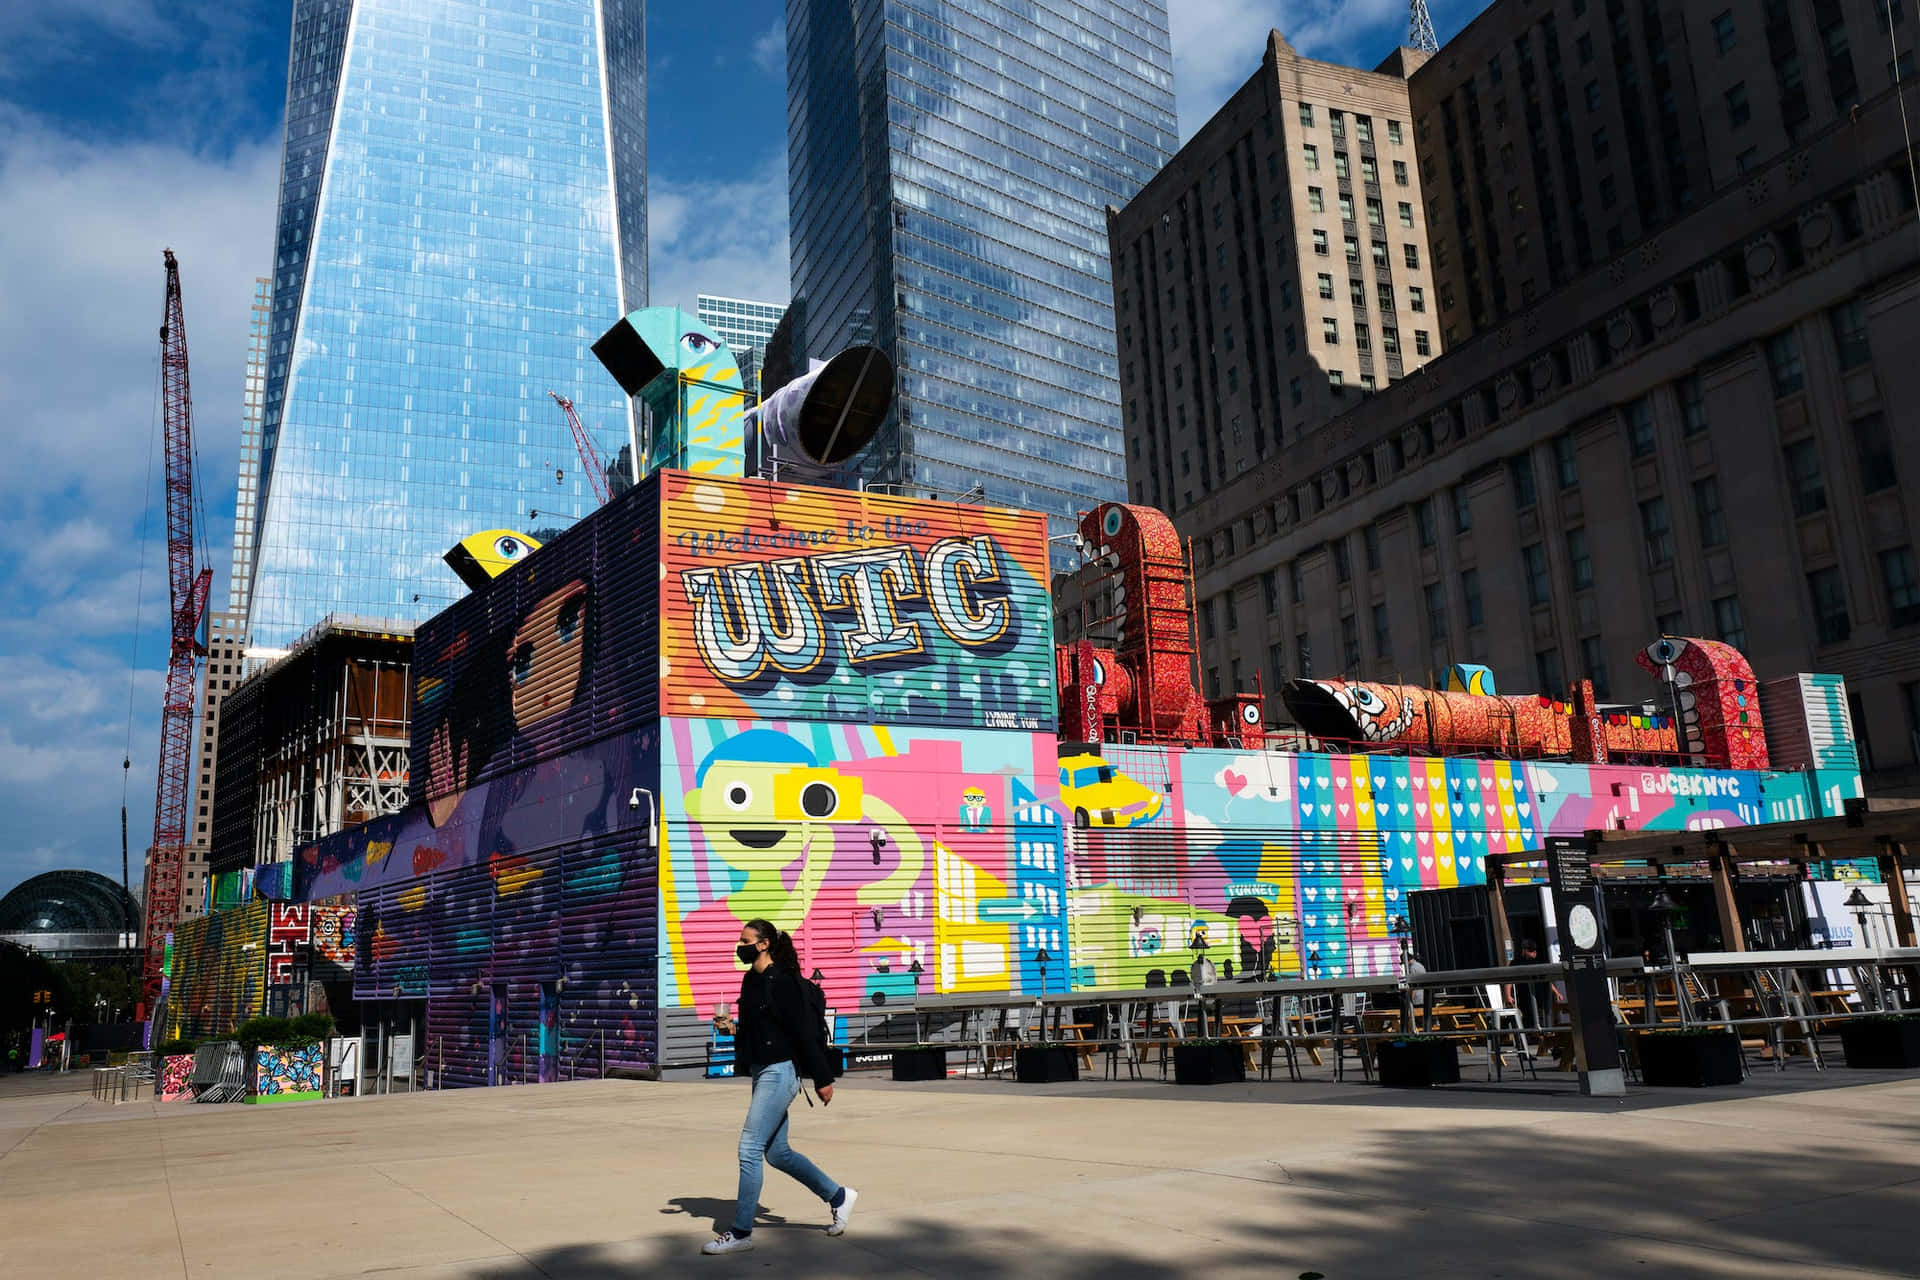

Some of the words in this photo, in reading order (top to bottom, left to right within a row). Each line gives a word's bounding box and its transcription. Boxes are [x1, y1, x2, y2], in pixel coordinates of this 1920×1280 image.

[677, 527, 839, 556] Welcome
[847, 520, 874, 541] to
[883, 515, 930, 537] the
[680, 535, 1014, 684] WTC
[1228, 884, 1277, 897] TUNNEL
